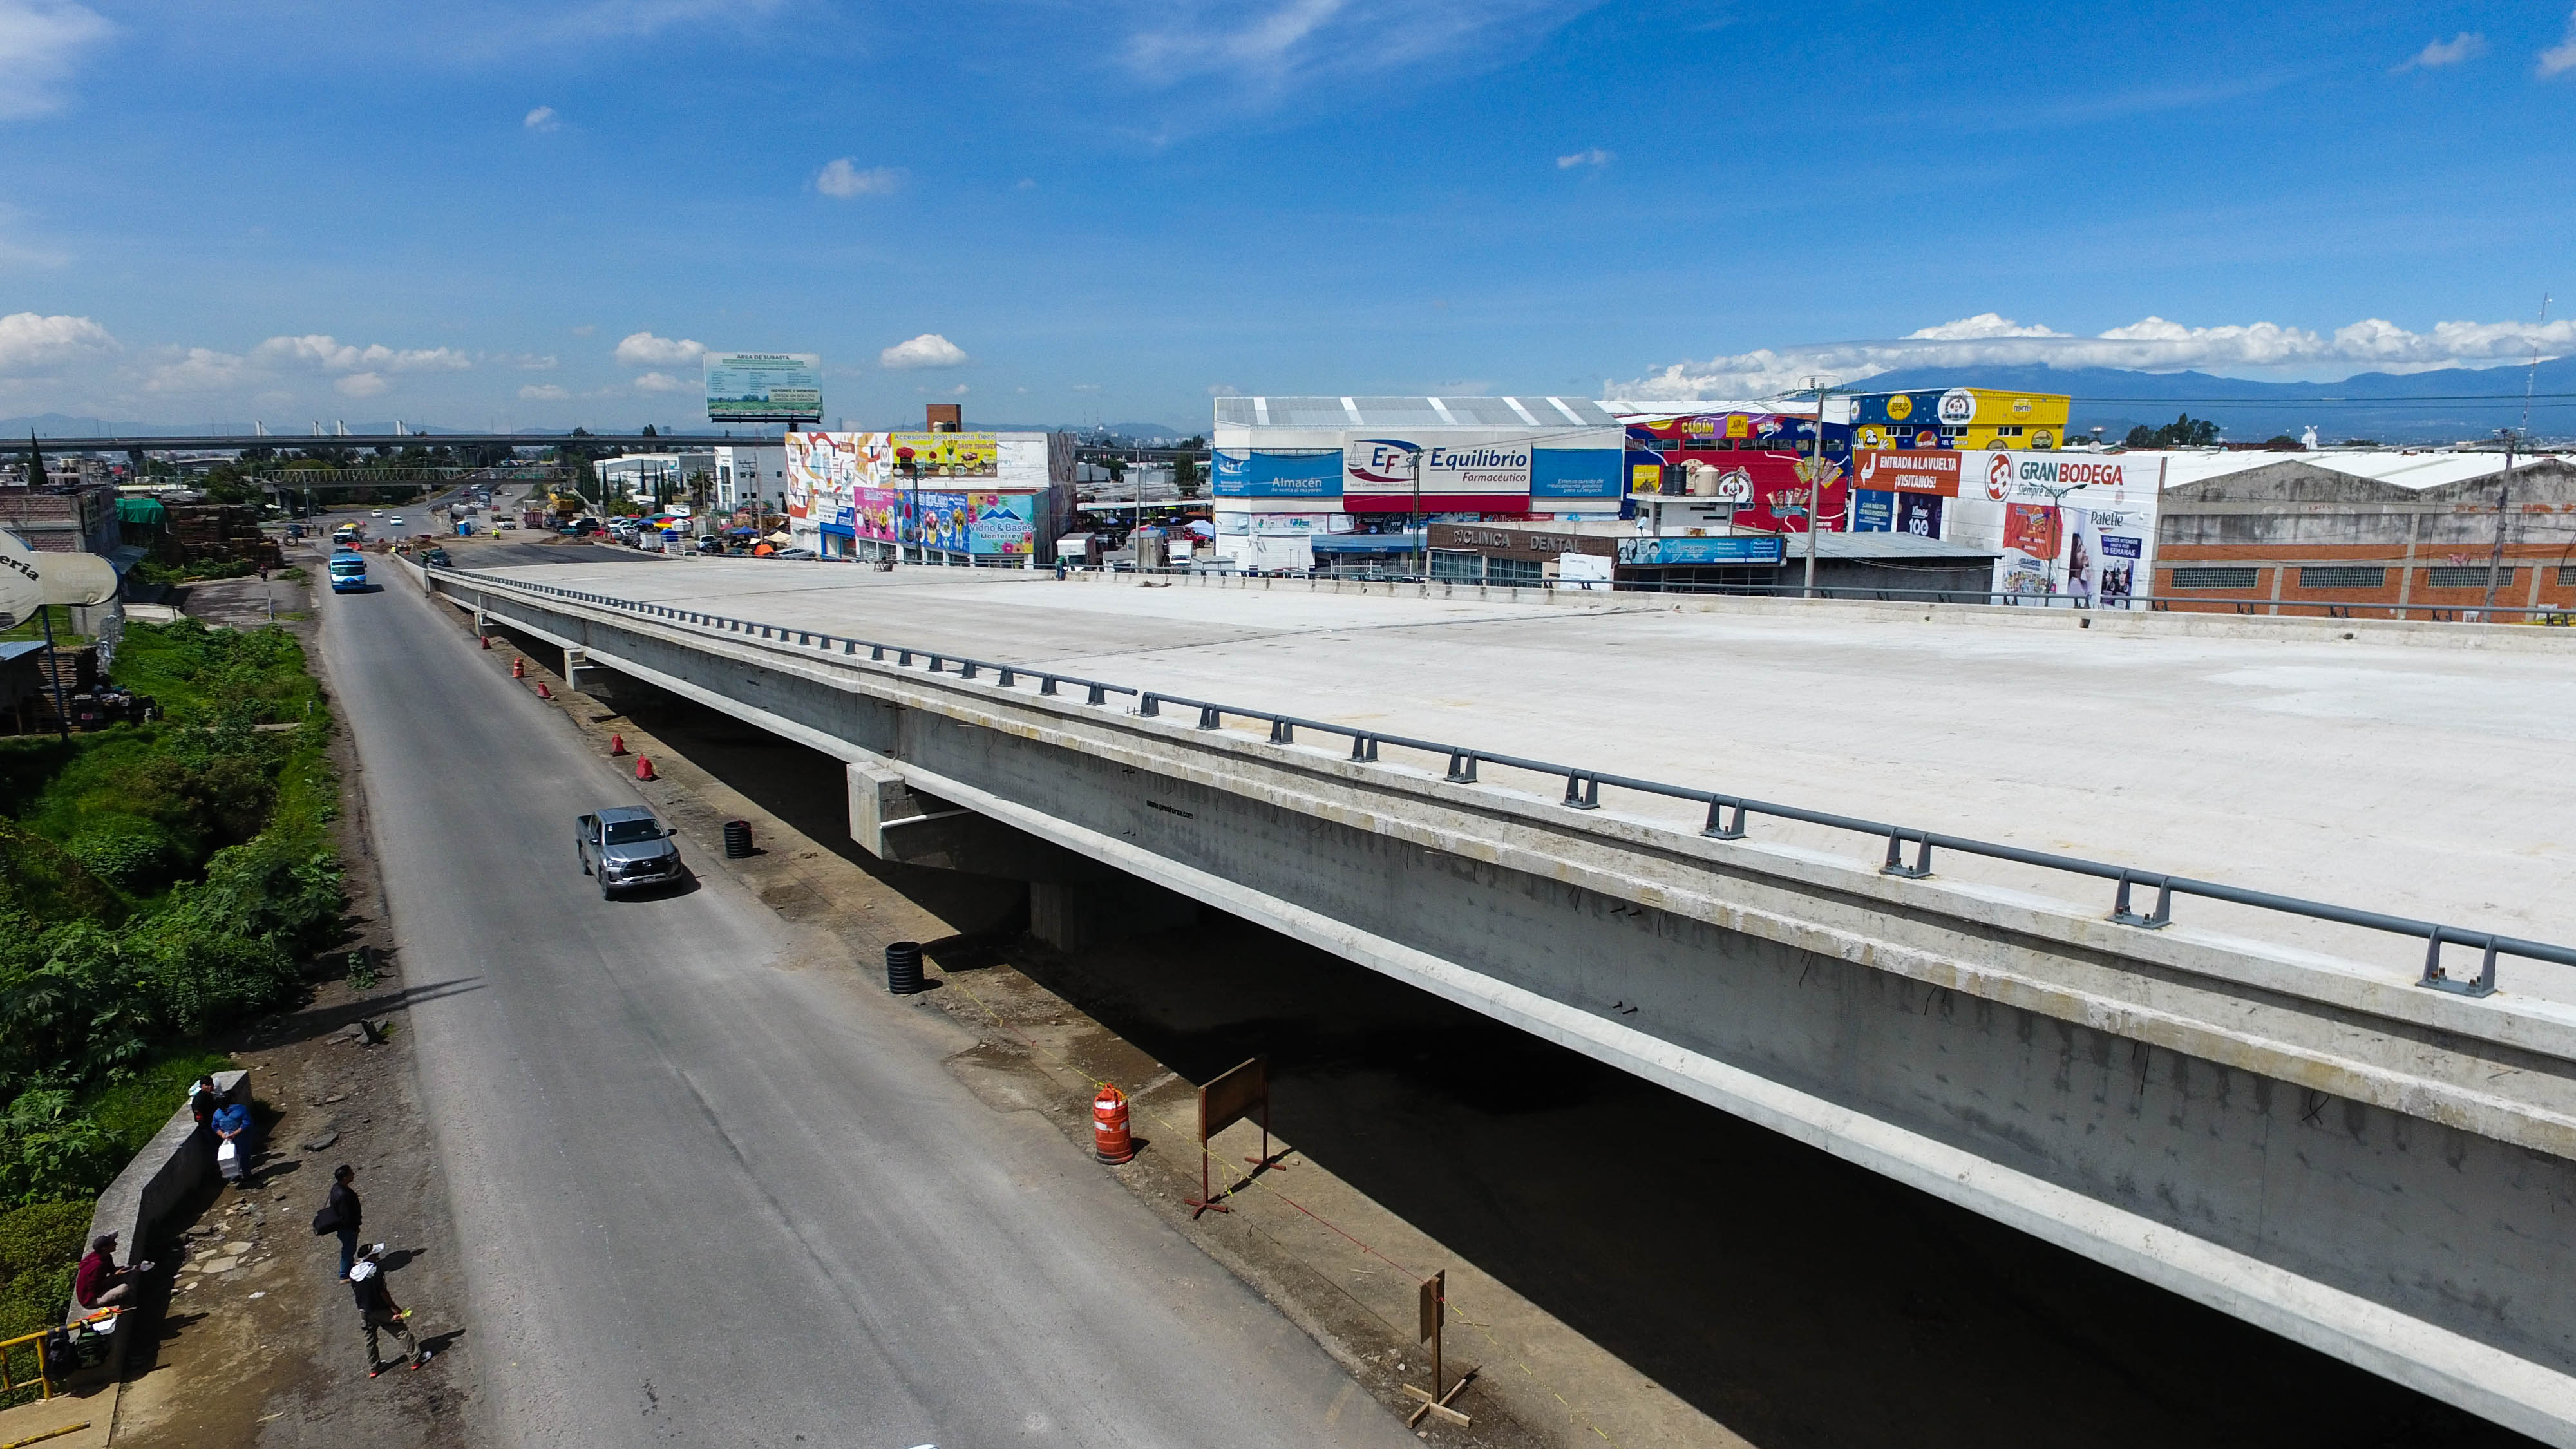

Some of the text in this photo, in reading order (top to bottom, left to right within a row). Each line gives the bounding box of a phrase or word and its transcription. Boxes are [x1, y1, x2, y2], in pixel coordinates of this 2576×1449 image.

[1429, 447, 1528, 471] Equilibrio
[1880, 455, 1912, 469] ENTRADA
[1912, 457, 1918, 469] A
[1926, 457, 1957, 471] VUELTA
[1462, 471, 1527, 482] Farmacéutico
[1272, 477, 1322, 488] Almacén
[2090, 511, 2124, 527] Palette
[969, 523, 1032, 533] Vidrio & Bases
[980, 533, 1022, 541] Monterrey
[1463, 530, 1582, 554] CLINICA DENTAL
[2110, 547, 2136, 556] SEMANAS
